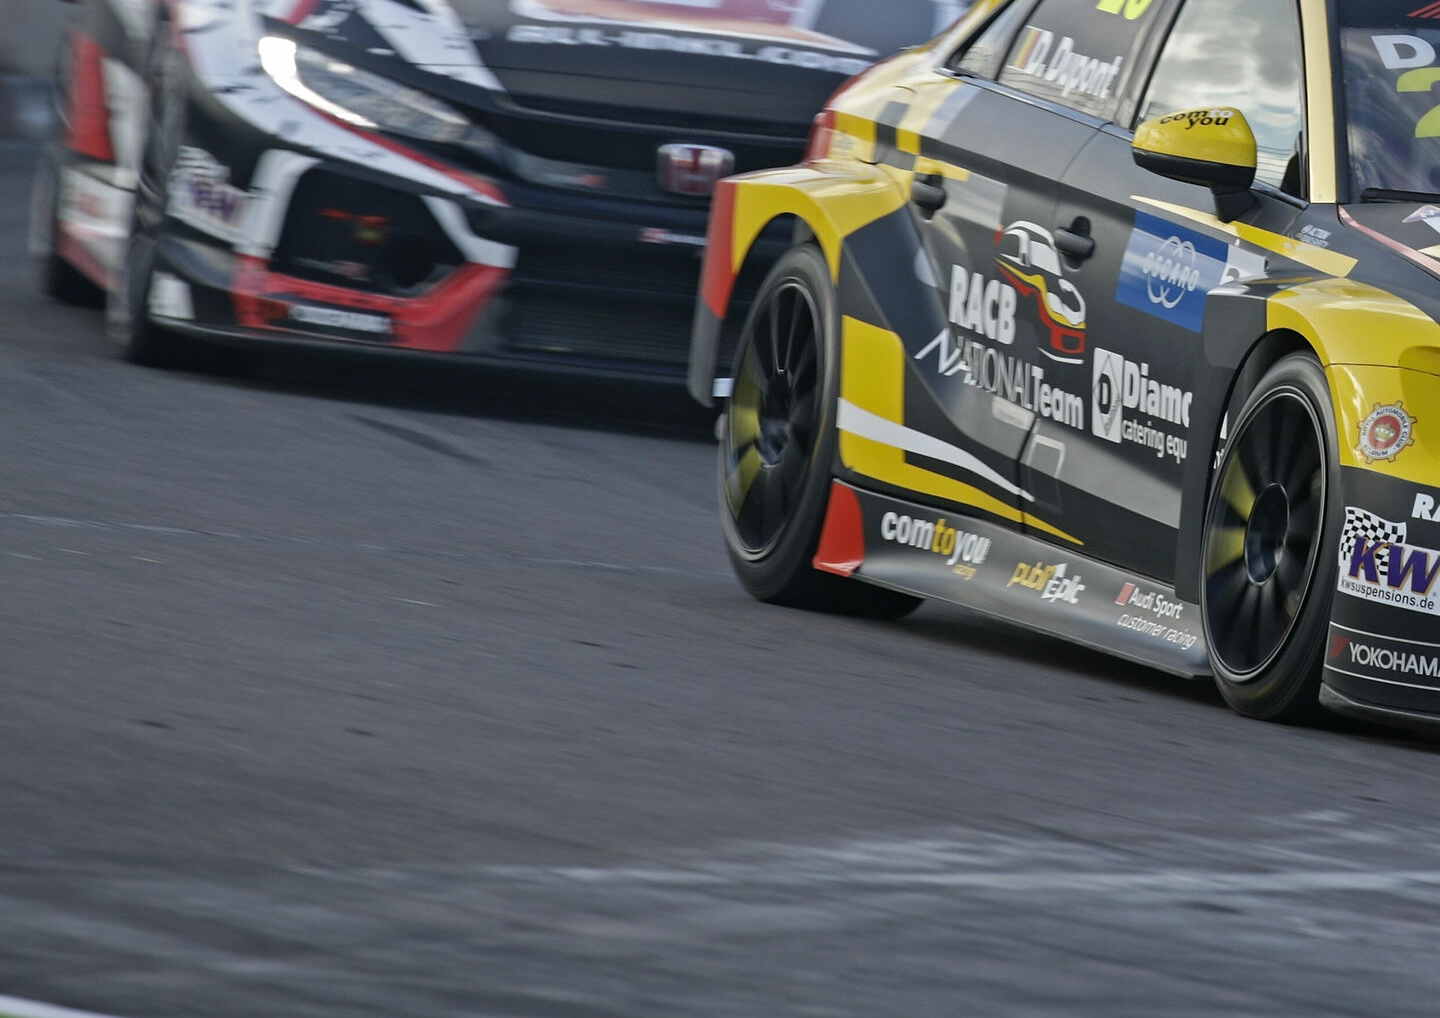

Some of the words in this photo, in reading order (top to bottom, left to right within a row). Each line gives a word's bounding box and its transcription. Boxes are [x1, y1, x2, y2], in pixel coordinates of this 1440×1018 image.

[1043, 35, 1124, 99] Dupont
[1184, 116, 1230, 131] you
[948, 263, 1018, 346] RACB
[1121, 419, 1166, 459] catering
[1127, 586, 1158, 611] Audi
[1152, 594, 1185, 620] Sport
[1341, 576, 1435, 611] kwsuspensions.de
[1116, 613, 1168, 638] customer
[1162, 627, 1198, 651] racing
